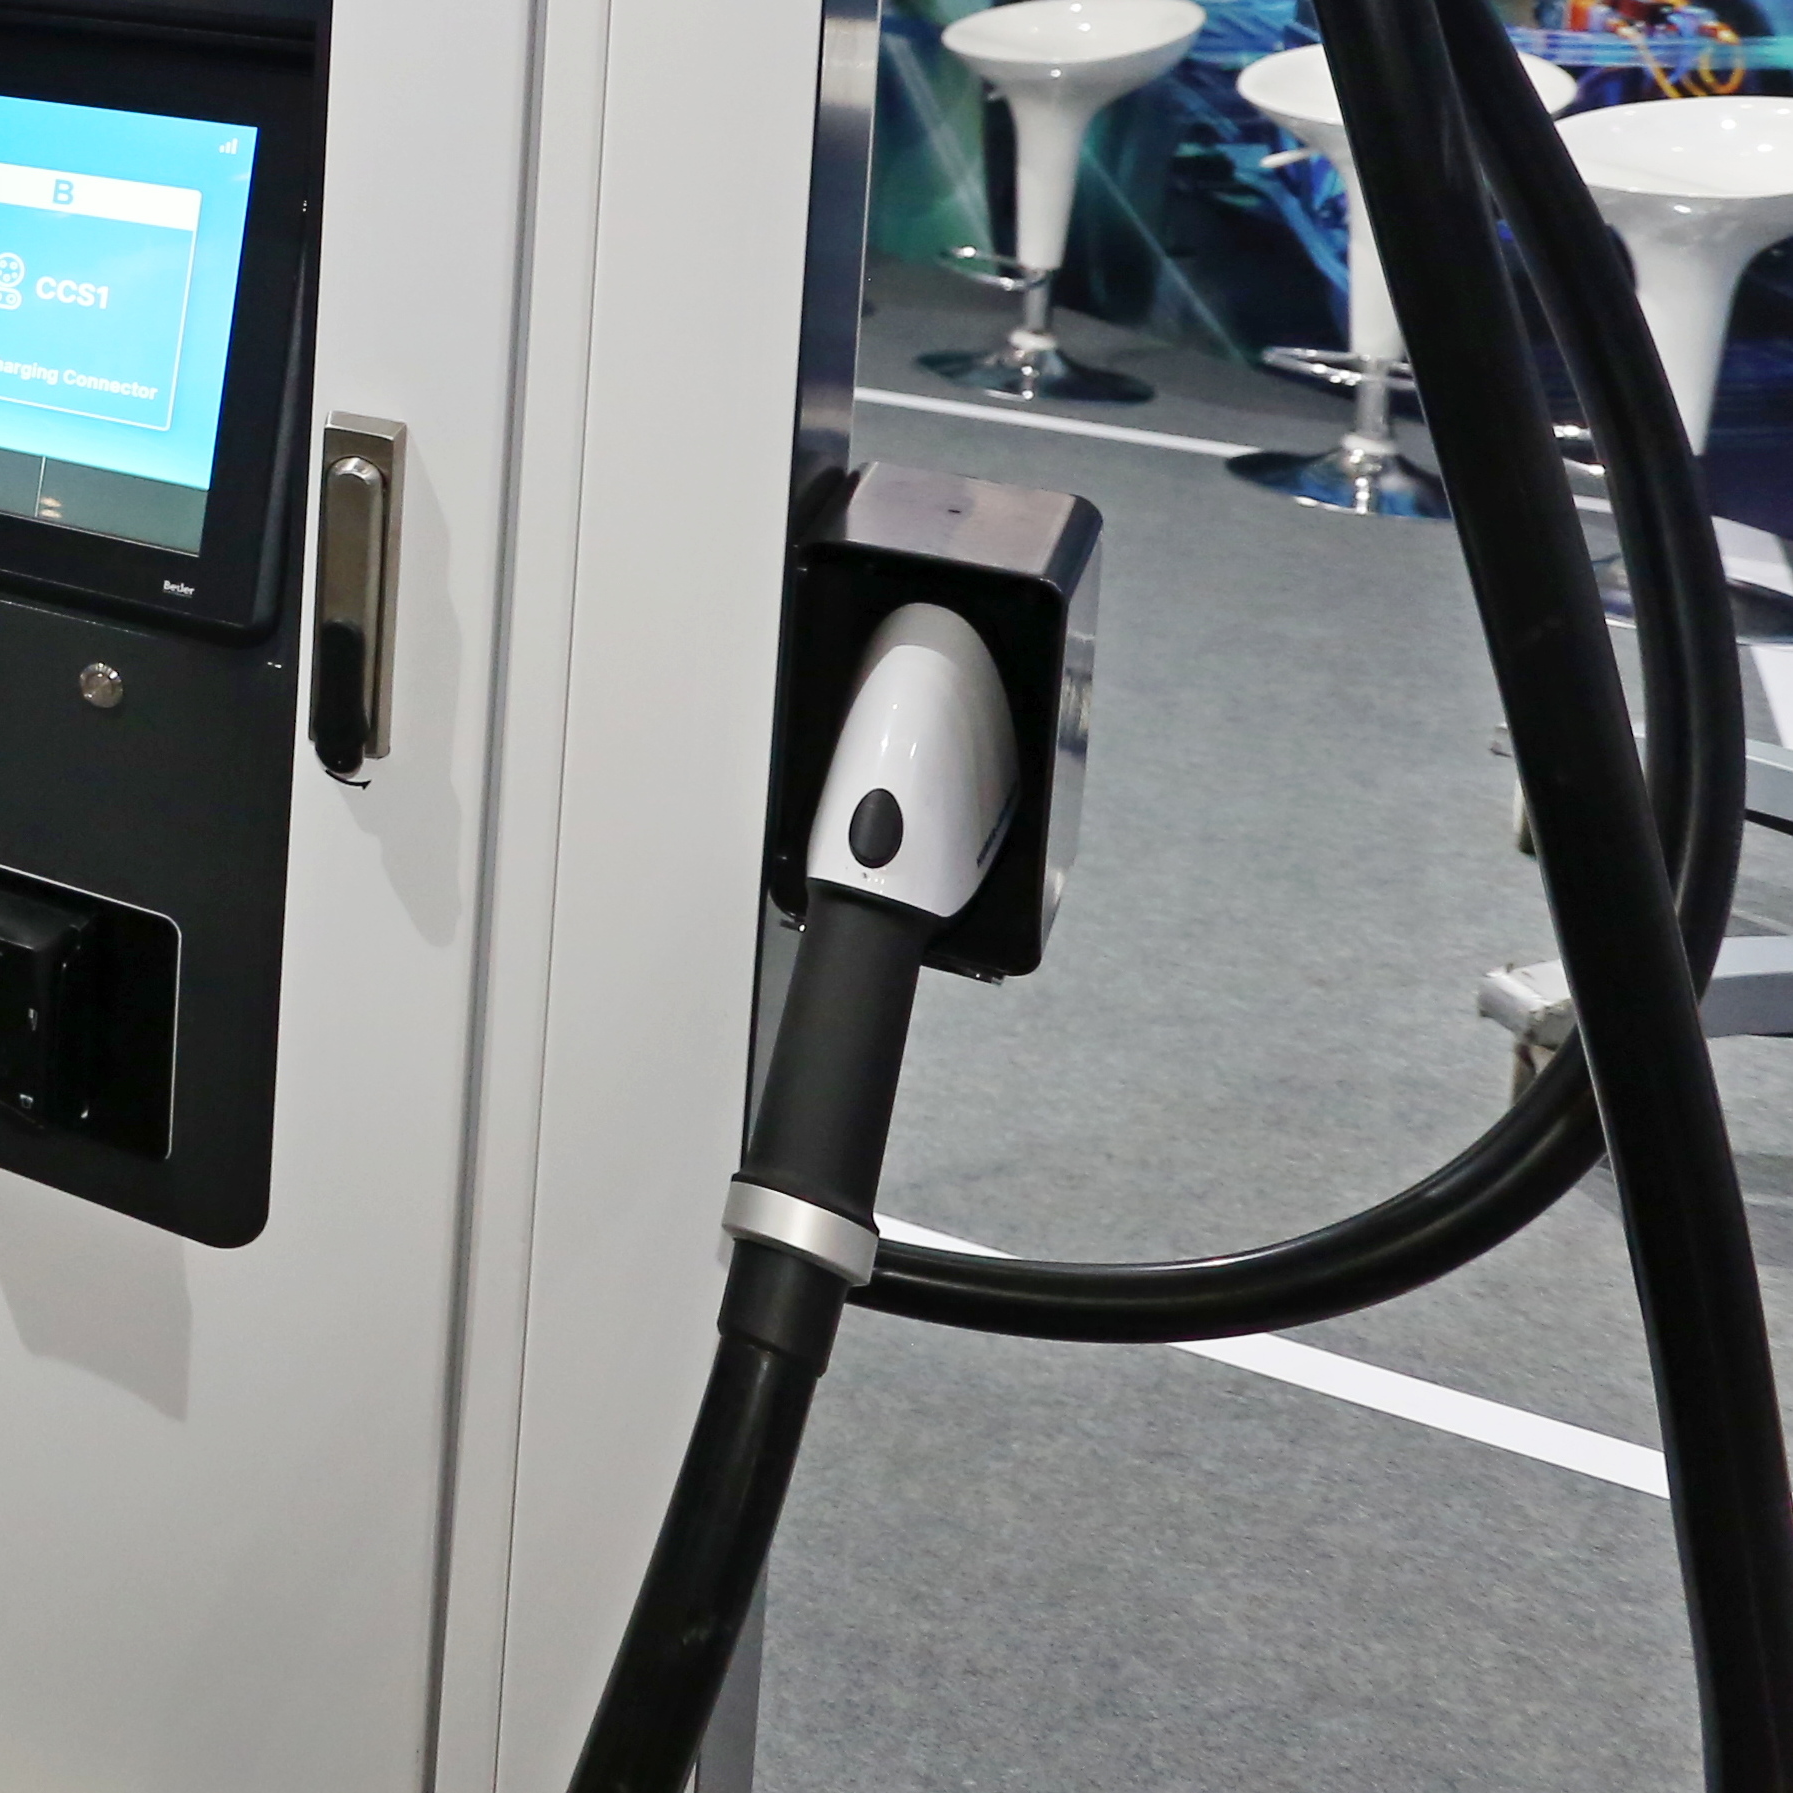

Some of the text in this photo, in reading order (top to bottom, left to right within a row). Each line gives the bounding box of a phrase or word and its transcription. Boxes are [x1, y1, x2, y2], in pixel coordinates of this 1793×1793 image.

[52, 179, 74, 205] B
[35, 275, 110, 310] CCS1
[63, 369, 158, 401] Connector
